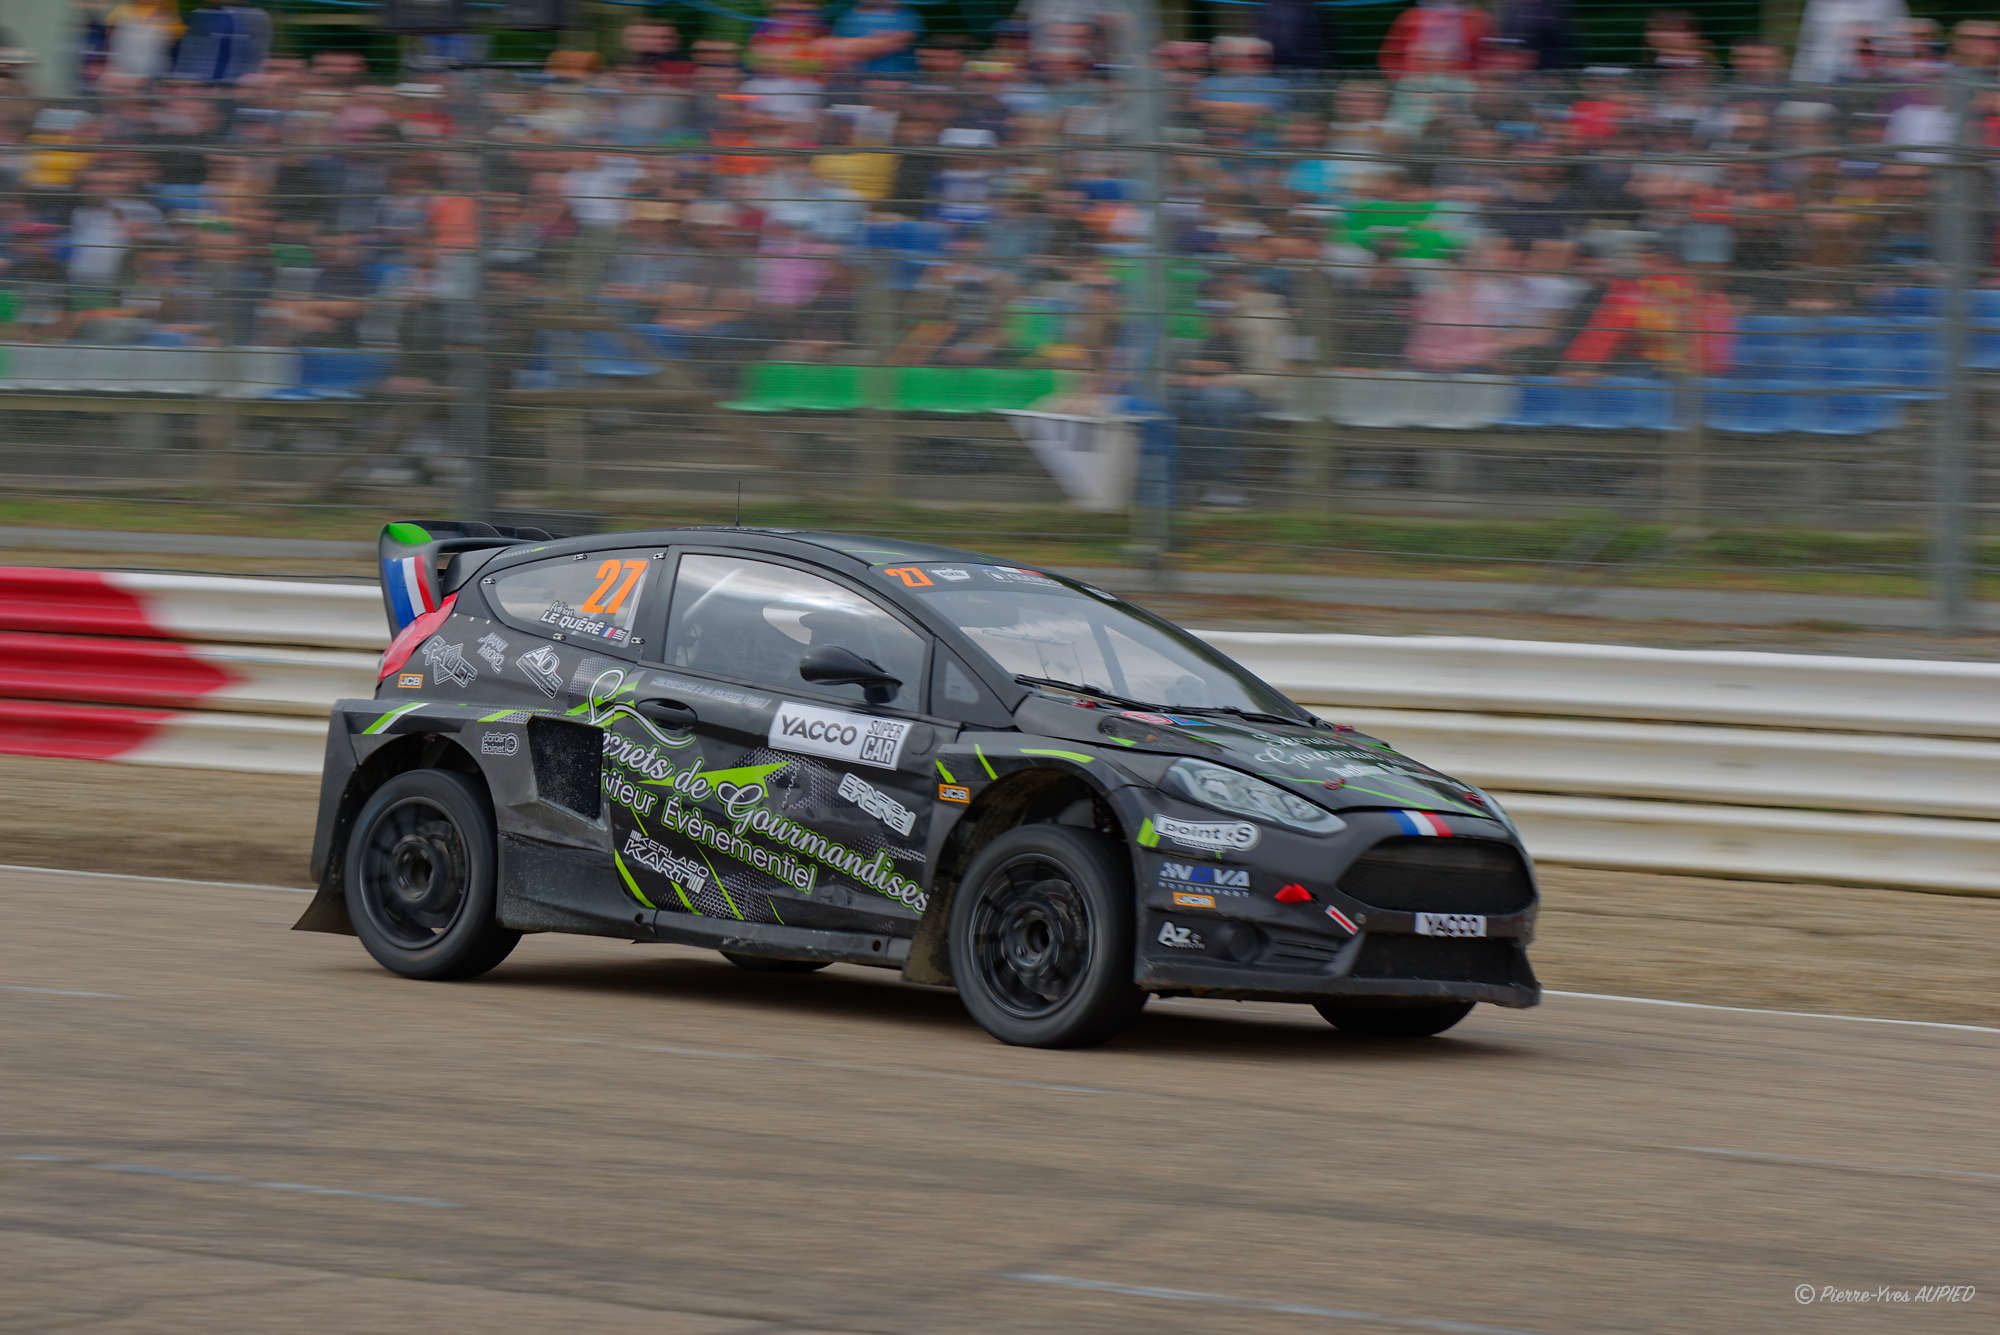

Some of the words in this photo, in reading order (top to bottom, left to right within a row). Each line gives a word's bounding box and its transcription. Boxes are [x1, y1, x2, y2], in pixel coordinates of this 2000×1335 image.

[582, 559, 648, 614] 27
[540, 611, 560, 624] LE
[400, 676, 420, 688] JCB
[781, 714, 857, 746] YACCO
[867, 720, 904, 738] SUPER
[862, 737, 895, 763] CAR
[663, 796, 815, 892] Évènementiel
[674, 759, 713, 799] de
[717, 782, 929, 912] Gourmandises
[624, 839, 691, 886] KART
[638, 833, 709, 878] KERLABO
[1424, 915, 1480, 935] YACCO
